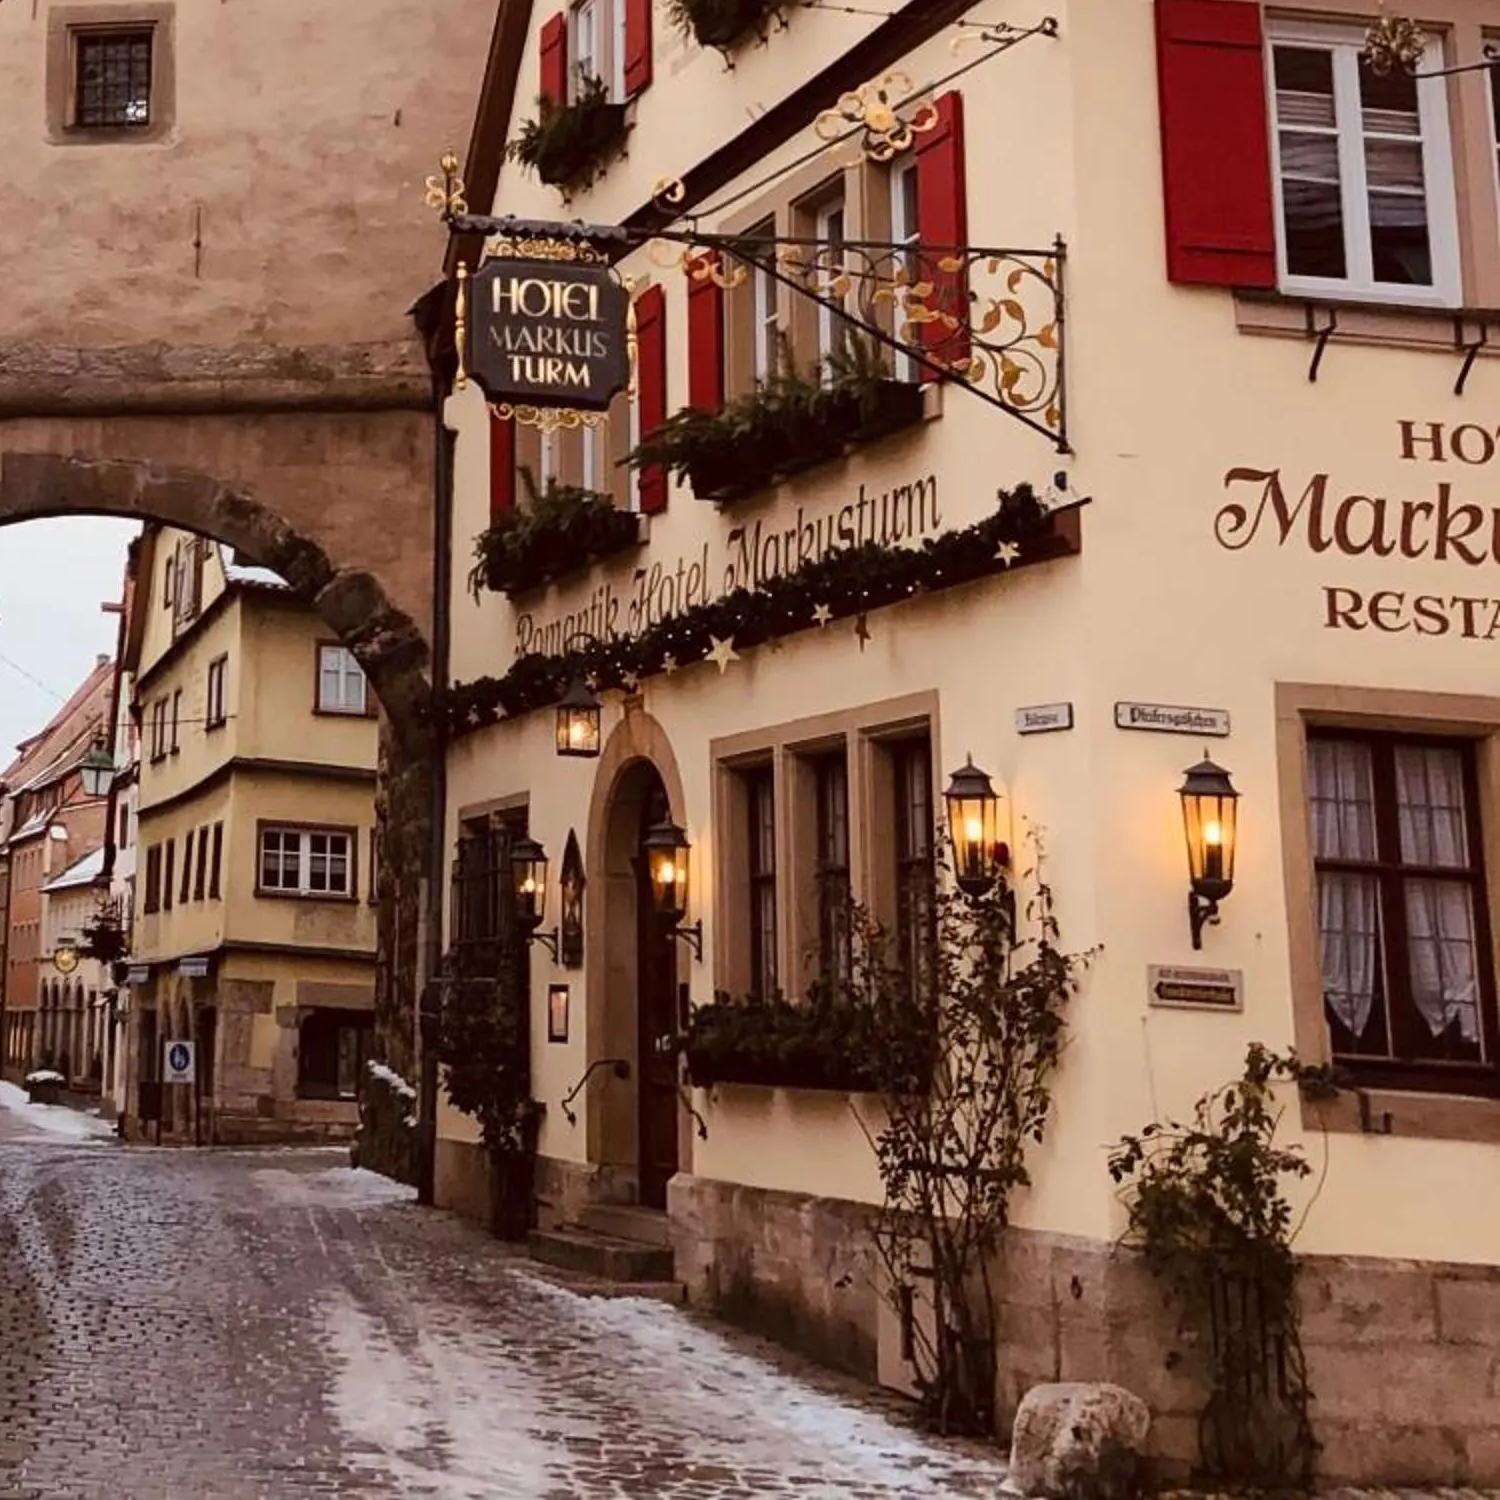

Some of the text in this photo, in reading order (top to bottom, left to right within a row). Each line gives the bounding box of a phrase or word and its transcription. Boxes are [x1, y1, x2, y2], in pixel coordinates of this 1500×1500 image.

[491, 276, 606, 322] HOTEL
[489, 324, 611, 358] MARKUS
[507, 353, 591, 389] TURM
[1397, 419, 1500, 465] HO
[1214, 466, 1500, 566] Mark
[515, 474, 942, 656] Romantik Hotel Markusturm
